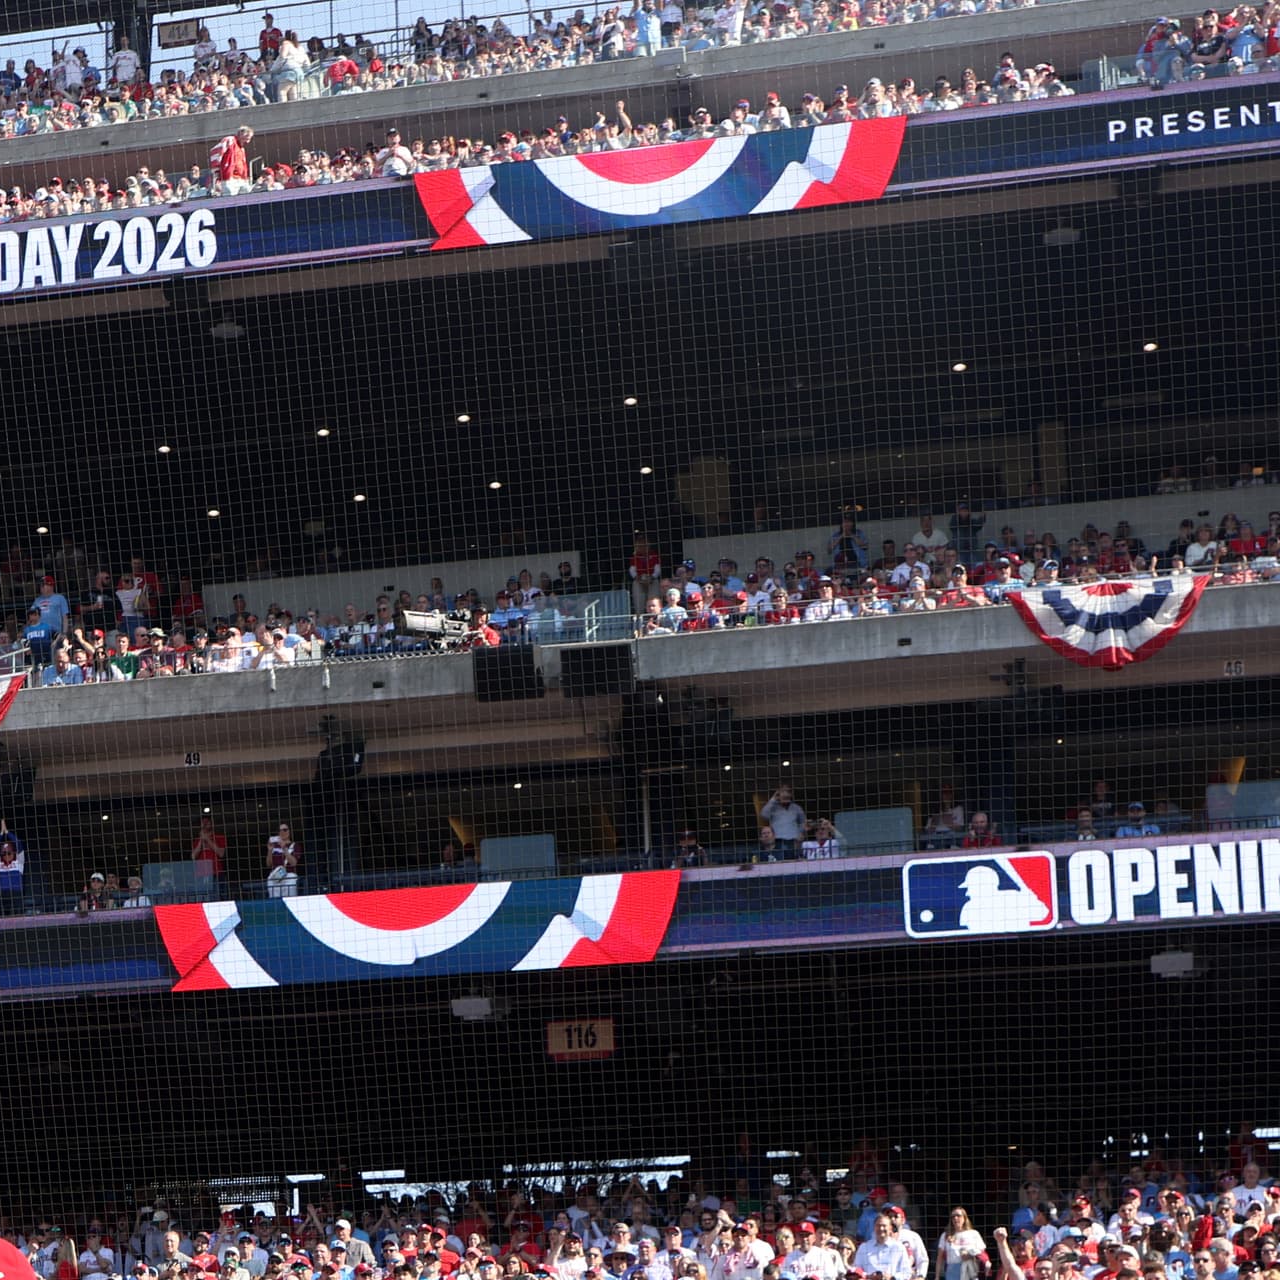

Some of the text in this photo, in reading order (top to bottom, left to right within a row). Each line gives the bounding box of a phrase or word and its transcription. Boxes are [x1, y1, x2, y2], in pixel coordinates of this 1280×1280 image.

[92, 208, 218, 280] 2026
[1224, 661, 1243, 676] 46
[184, 751, 201, 766] 49
[565, 1022, 598, 1050] 116
